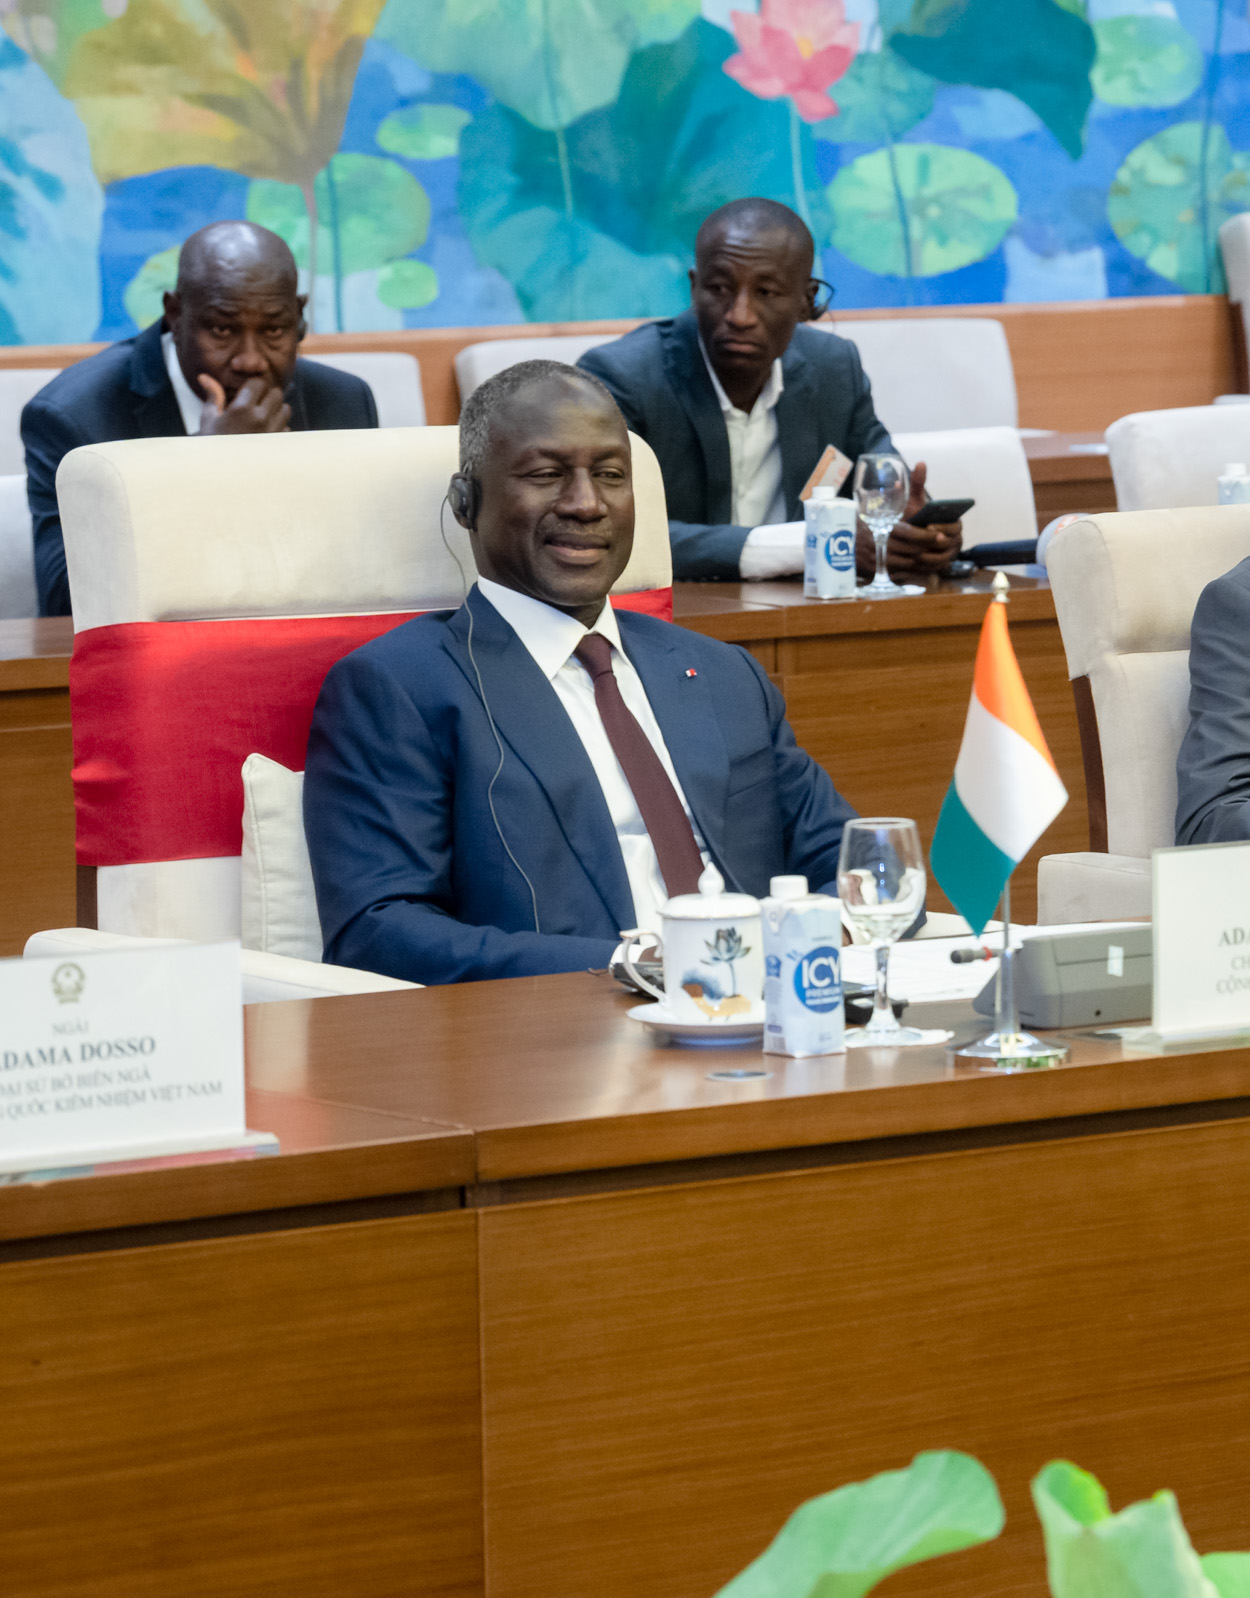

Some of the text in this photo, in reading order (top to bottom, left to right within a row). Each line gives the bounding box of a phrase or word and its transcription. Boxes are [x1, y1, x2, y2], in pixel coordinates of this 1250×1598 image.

[802, 956, 839, 988] ICY
[0, 1035, 156, 1072] DAMA DOSSO
[187, 1080, 223, 1098] NAM
